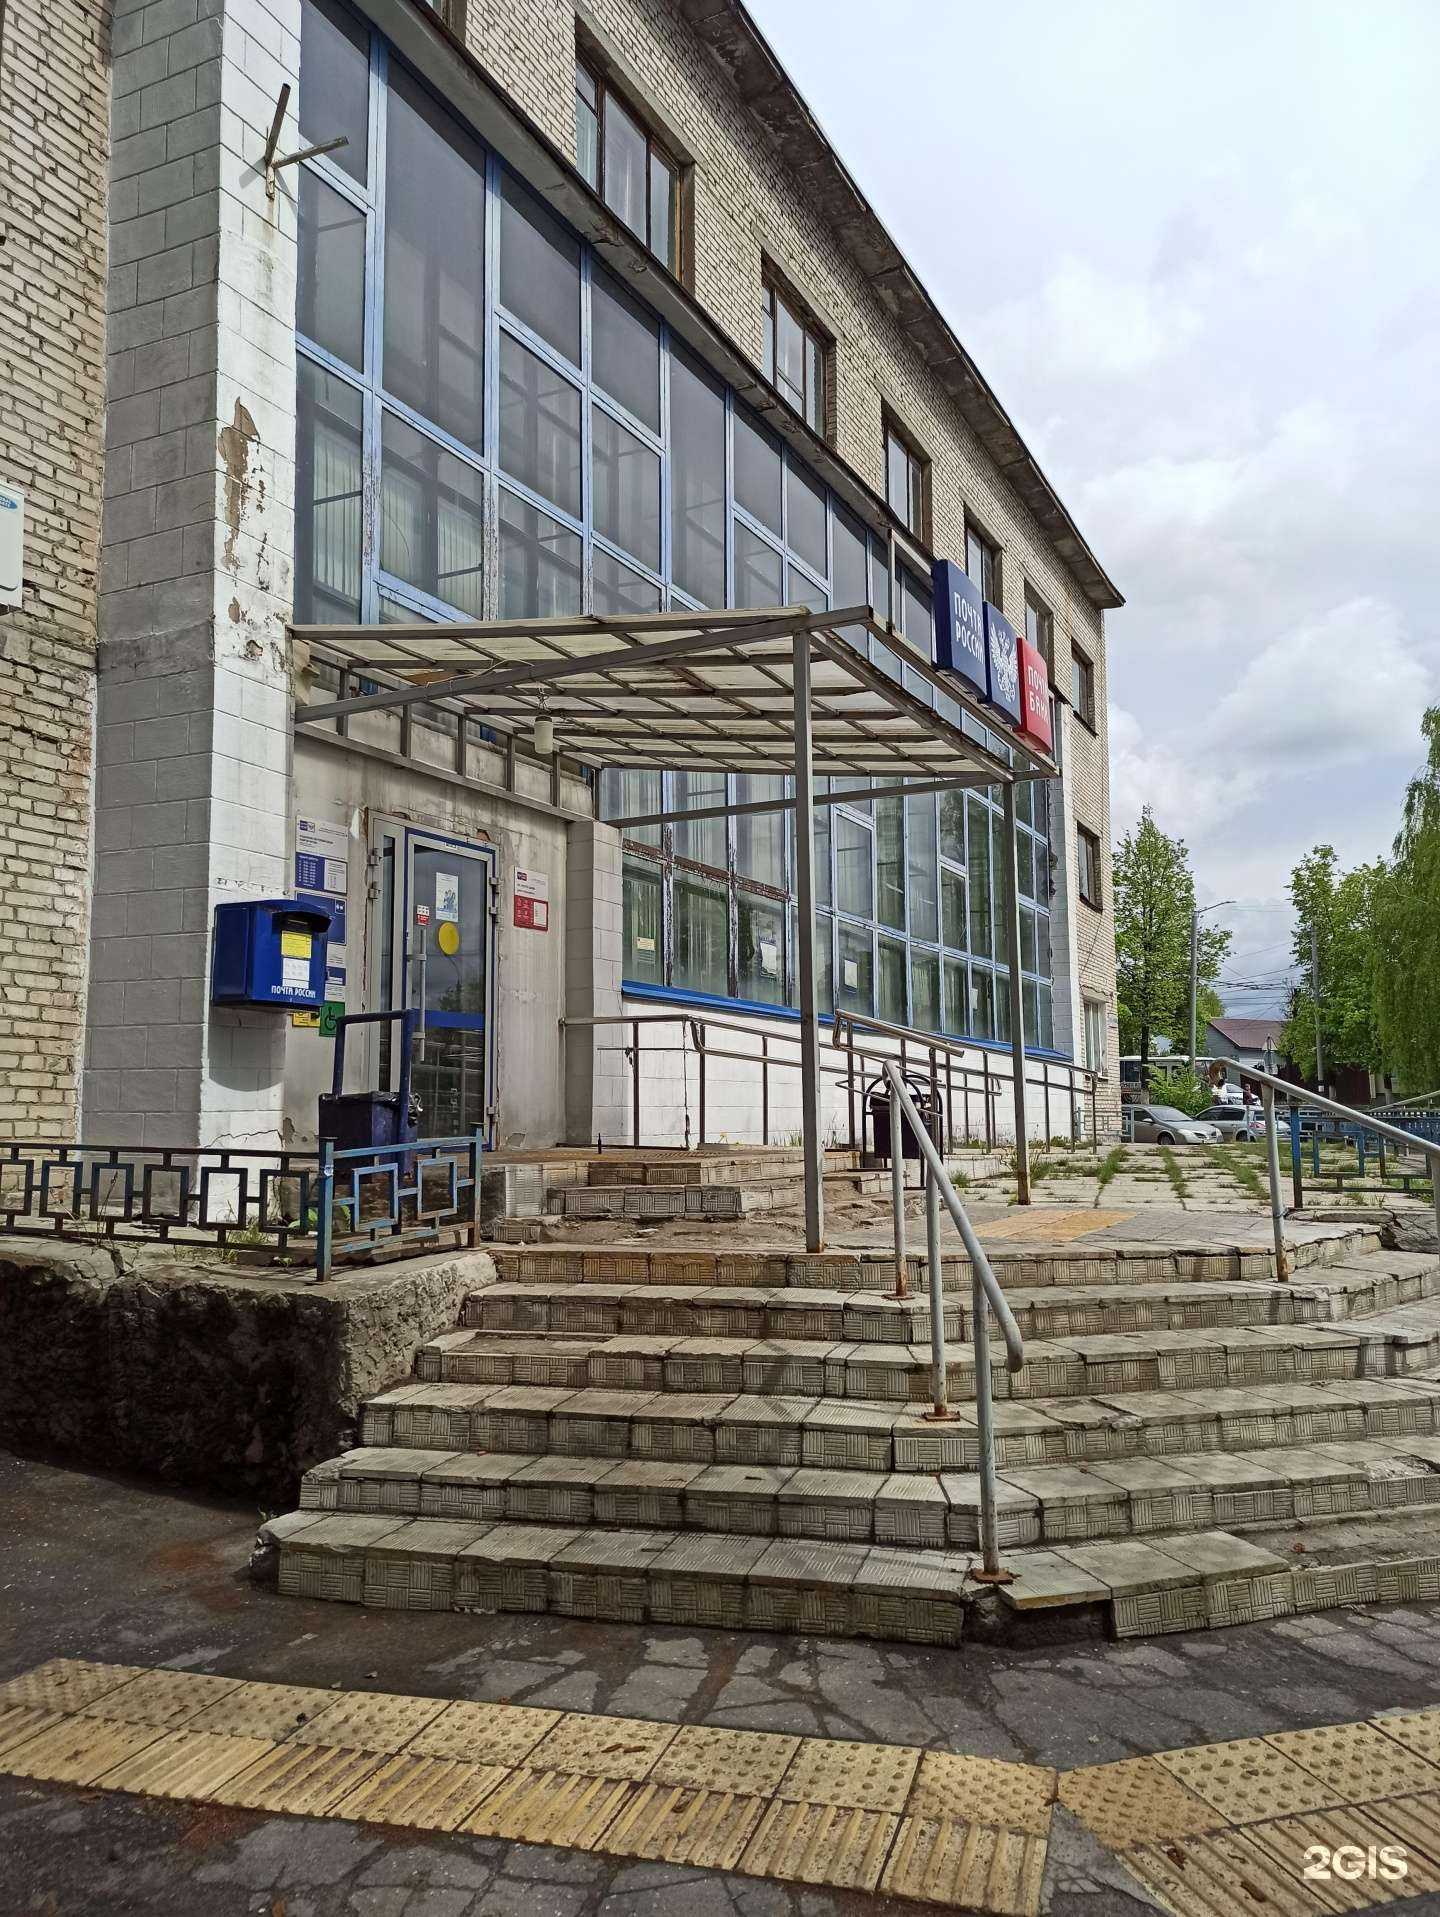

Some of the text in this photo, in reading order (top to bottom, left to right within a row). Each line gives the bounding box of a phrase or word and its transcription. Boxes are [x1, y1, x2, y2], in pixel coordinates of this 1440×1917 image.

[954, 591, 983, 635] ПОЧТА
[955, 620, 985, 665] РОССИИ
[271, 985, 293, 996] ПОЧТА
[294, 987, 316, 999] РОССИИ
